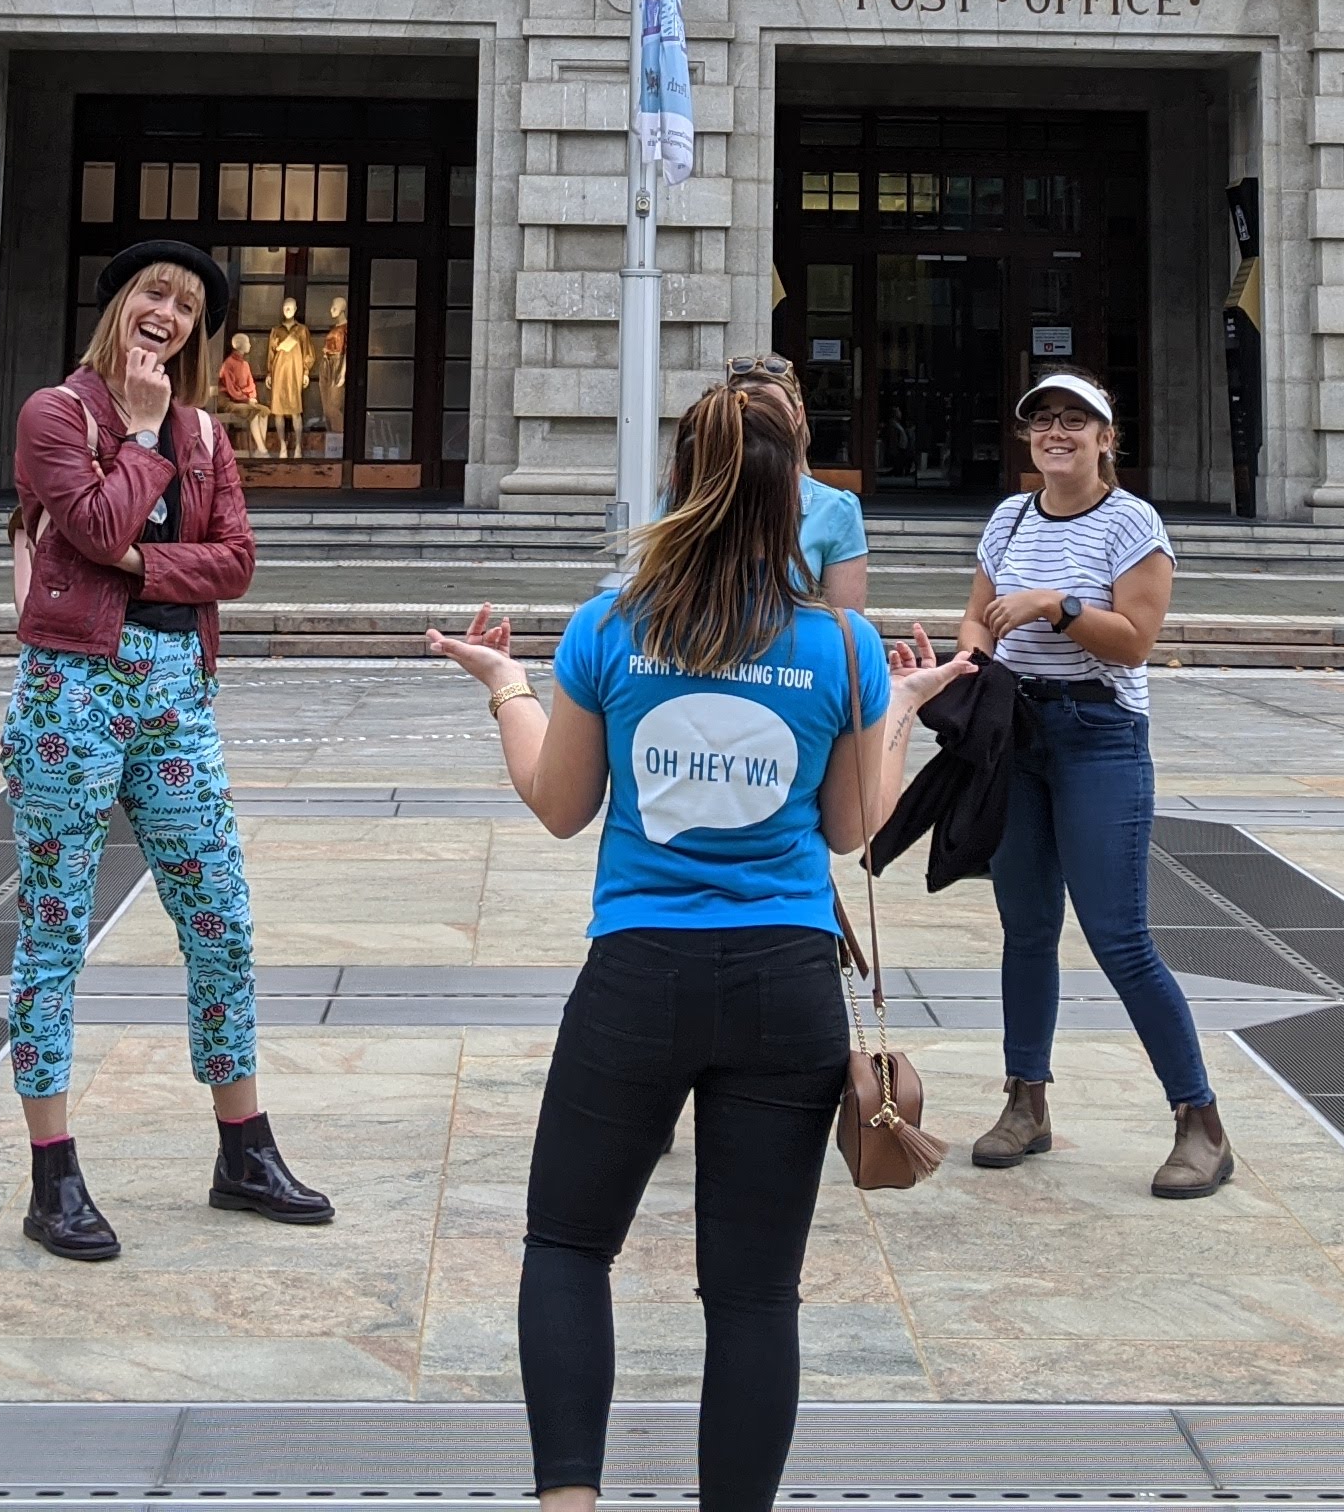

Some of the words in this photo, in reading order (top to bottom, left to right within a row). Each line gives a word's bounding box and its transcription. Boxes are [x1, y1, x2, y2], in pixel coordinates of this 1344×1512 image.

[777, 666, 814, 691] TOUR
[645, 746, 678, 778] OH
[689, 752, 736, 783] HEY
[745, 756, 779, 787] WA
